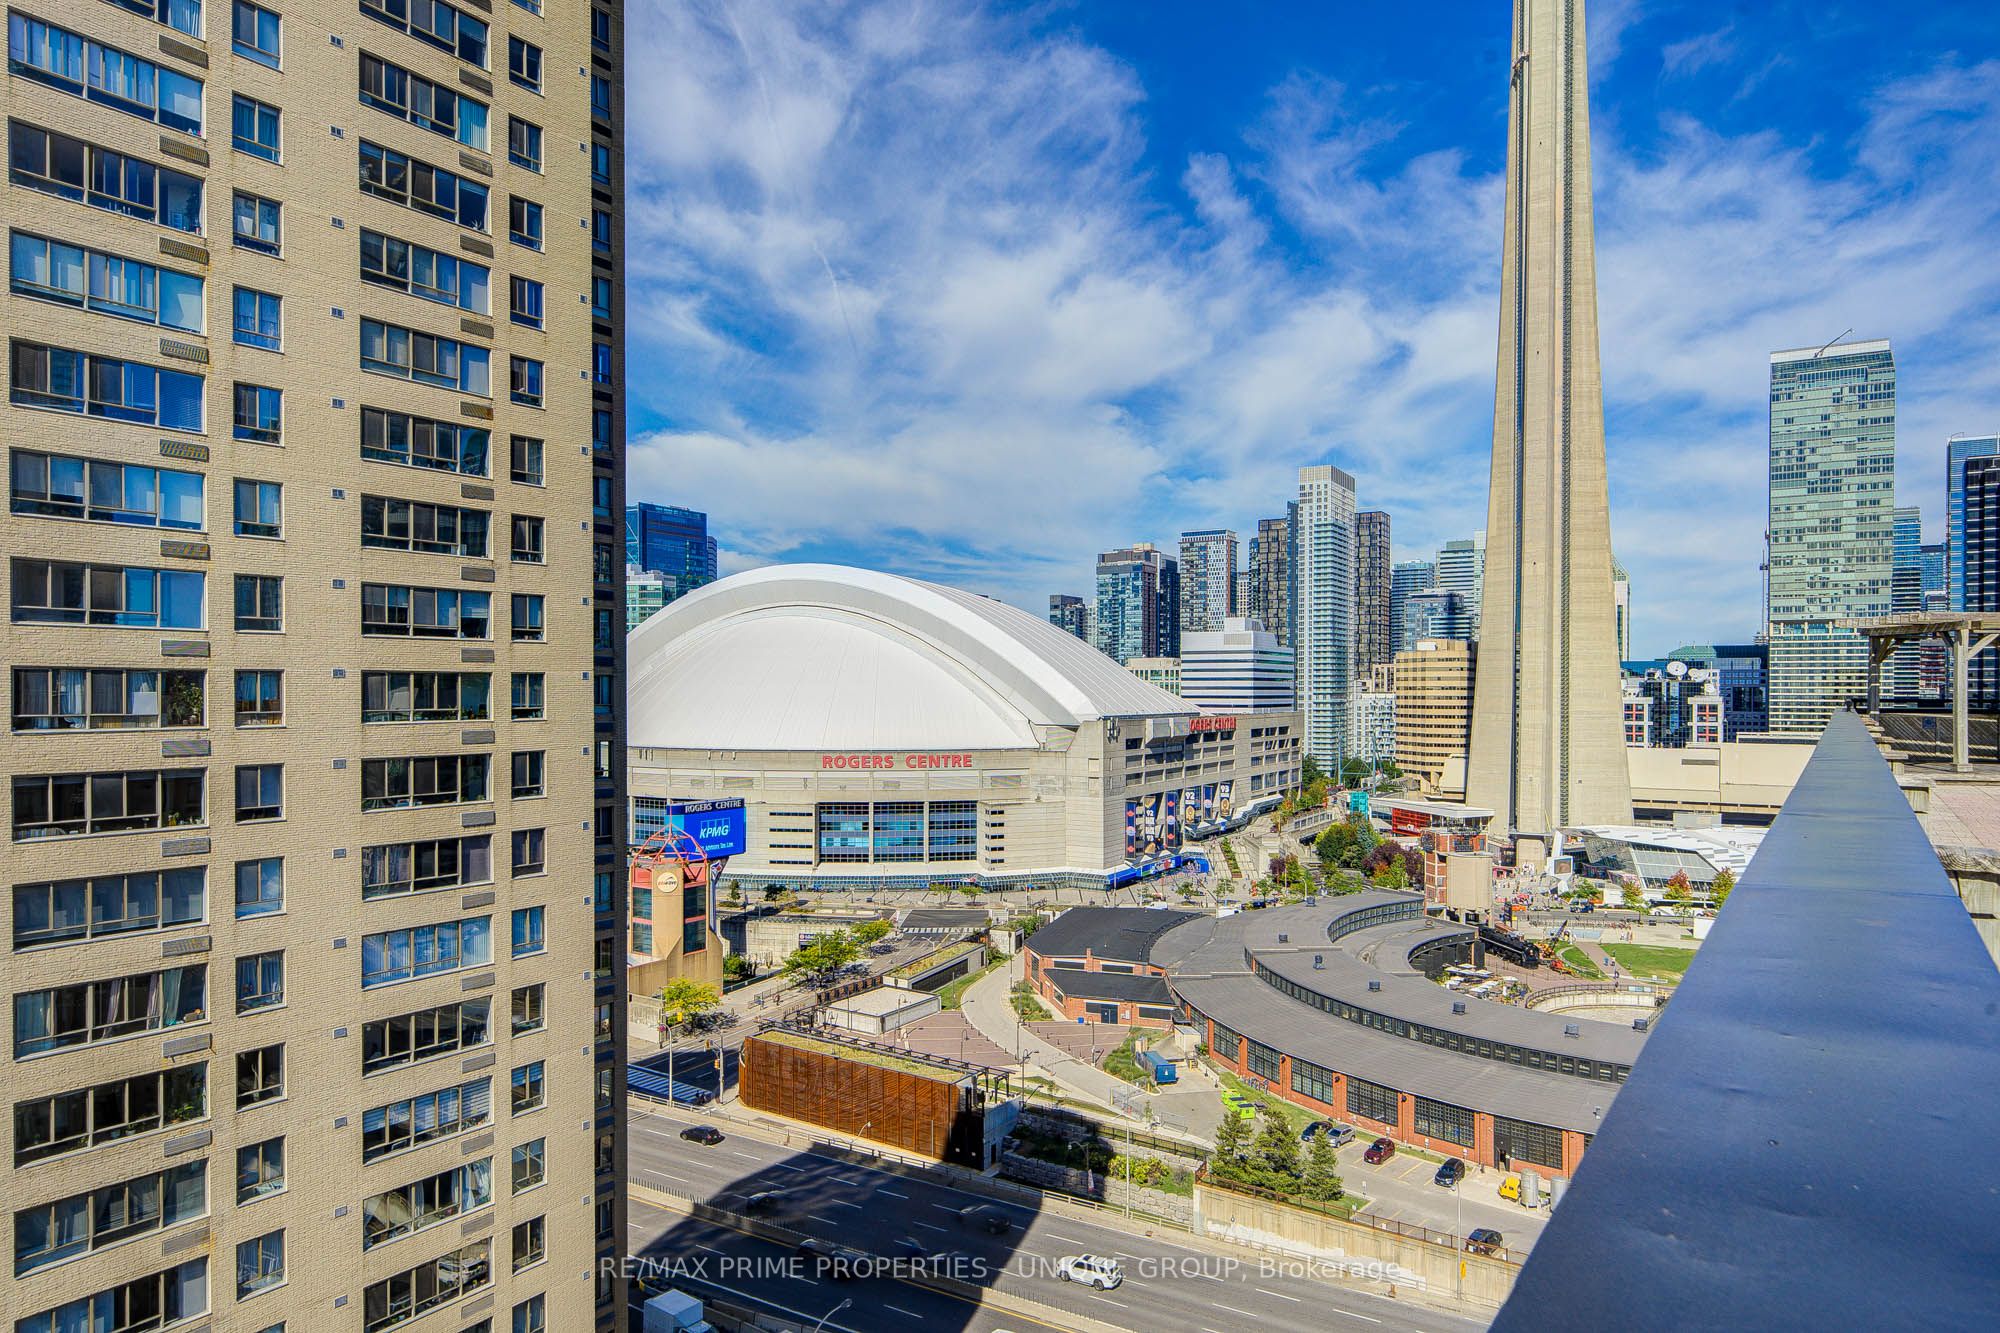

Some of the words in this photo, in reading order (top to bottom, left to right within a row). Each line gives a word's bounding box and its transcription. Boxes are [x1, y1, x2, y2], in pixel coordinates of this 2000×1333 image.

[822, 754, 895, 769] ROGERS
[905, 753, 973, 769] CENTRE
[1185, 791, 1195, 800] 92
[685, 802, 712, 814] ROGERS
[715, 800, 742, 810] CENTRE
[699, 825, 729, 839] KPMG
